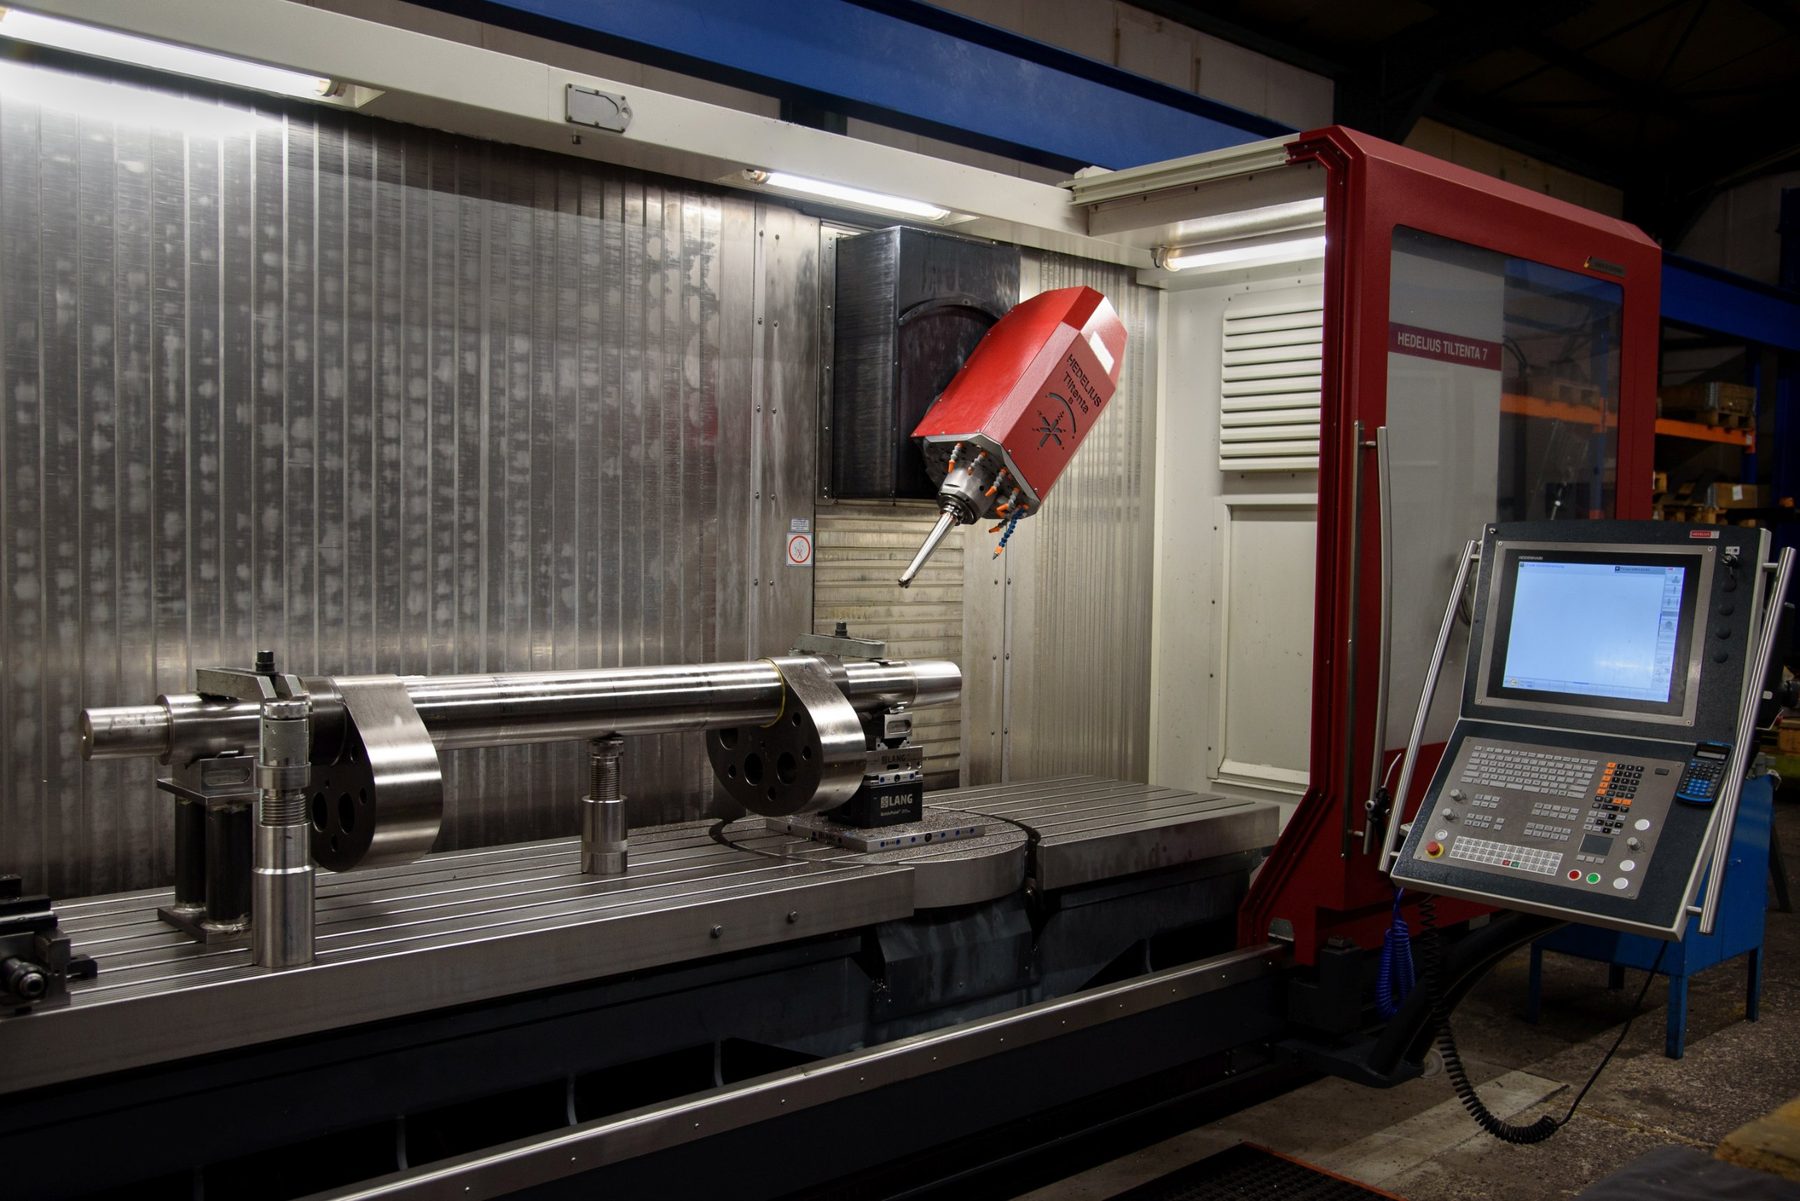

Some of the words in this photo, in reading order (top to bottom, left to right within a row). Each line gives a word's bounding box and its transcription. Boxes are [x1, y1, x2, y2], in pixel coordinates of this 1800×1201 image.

[1397, 332, 1441, 353] HEDELIUS
[1443, 340, 1480, 360] TILTENTA
[1483, 348, 1488, 361] 7
[1063, 371, 1089, 414] Tiltenta
[1067, 354, 1102, 407] HEDELIUS
[890, 794, 913, 806] LANG
